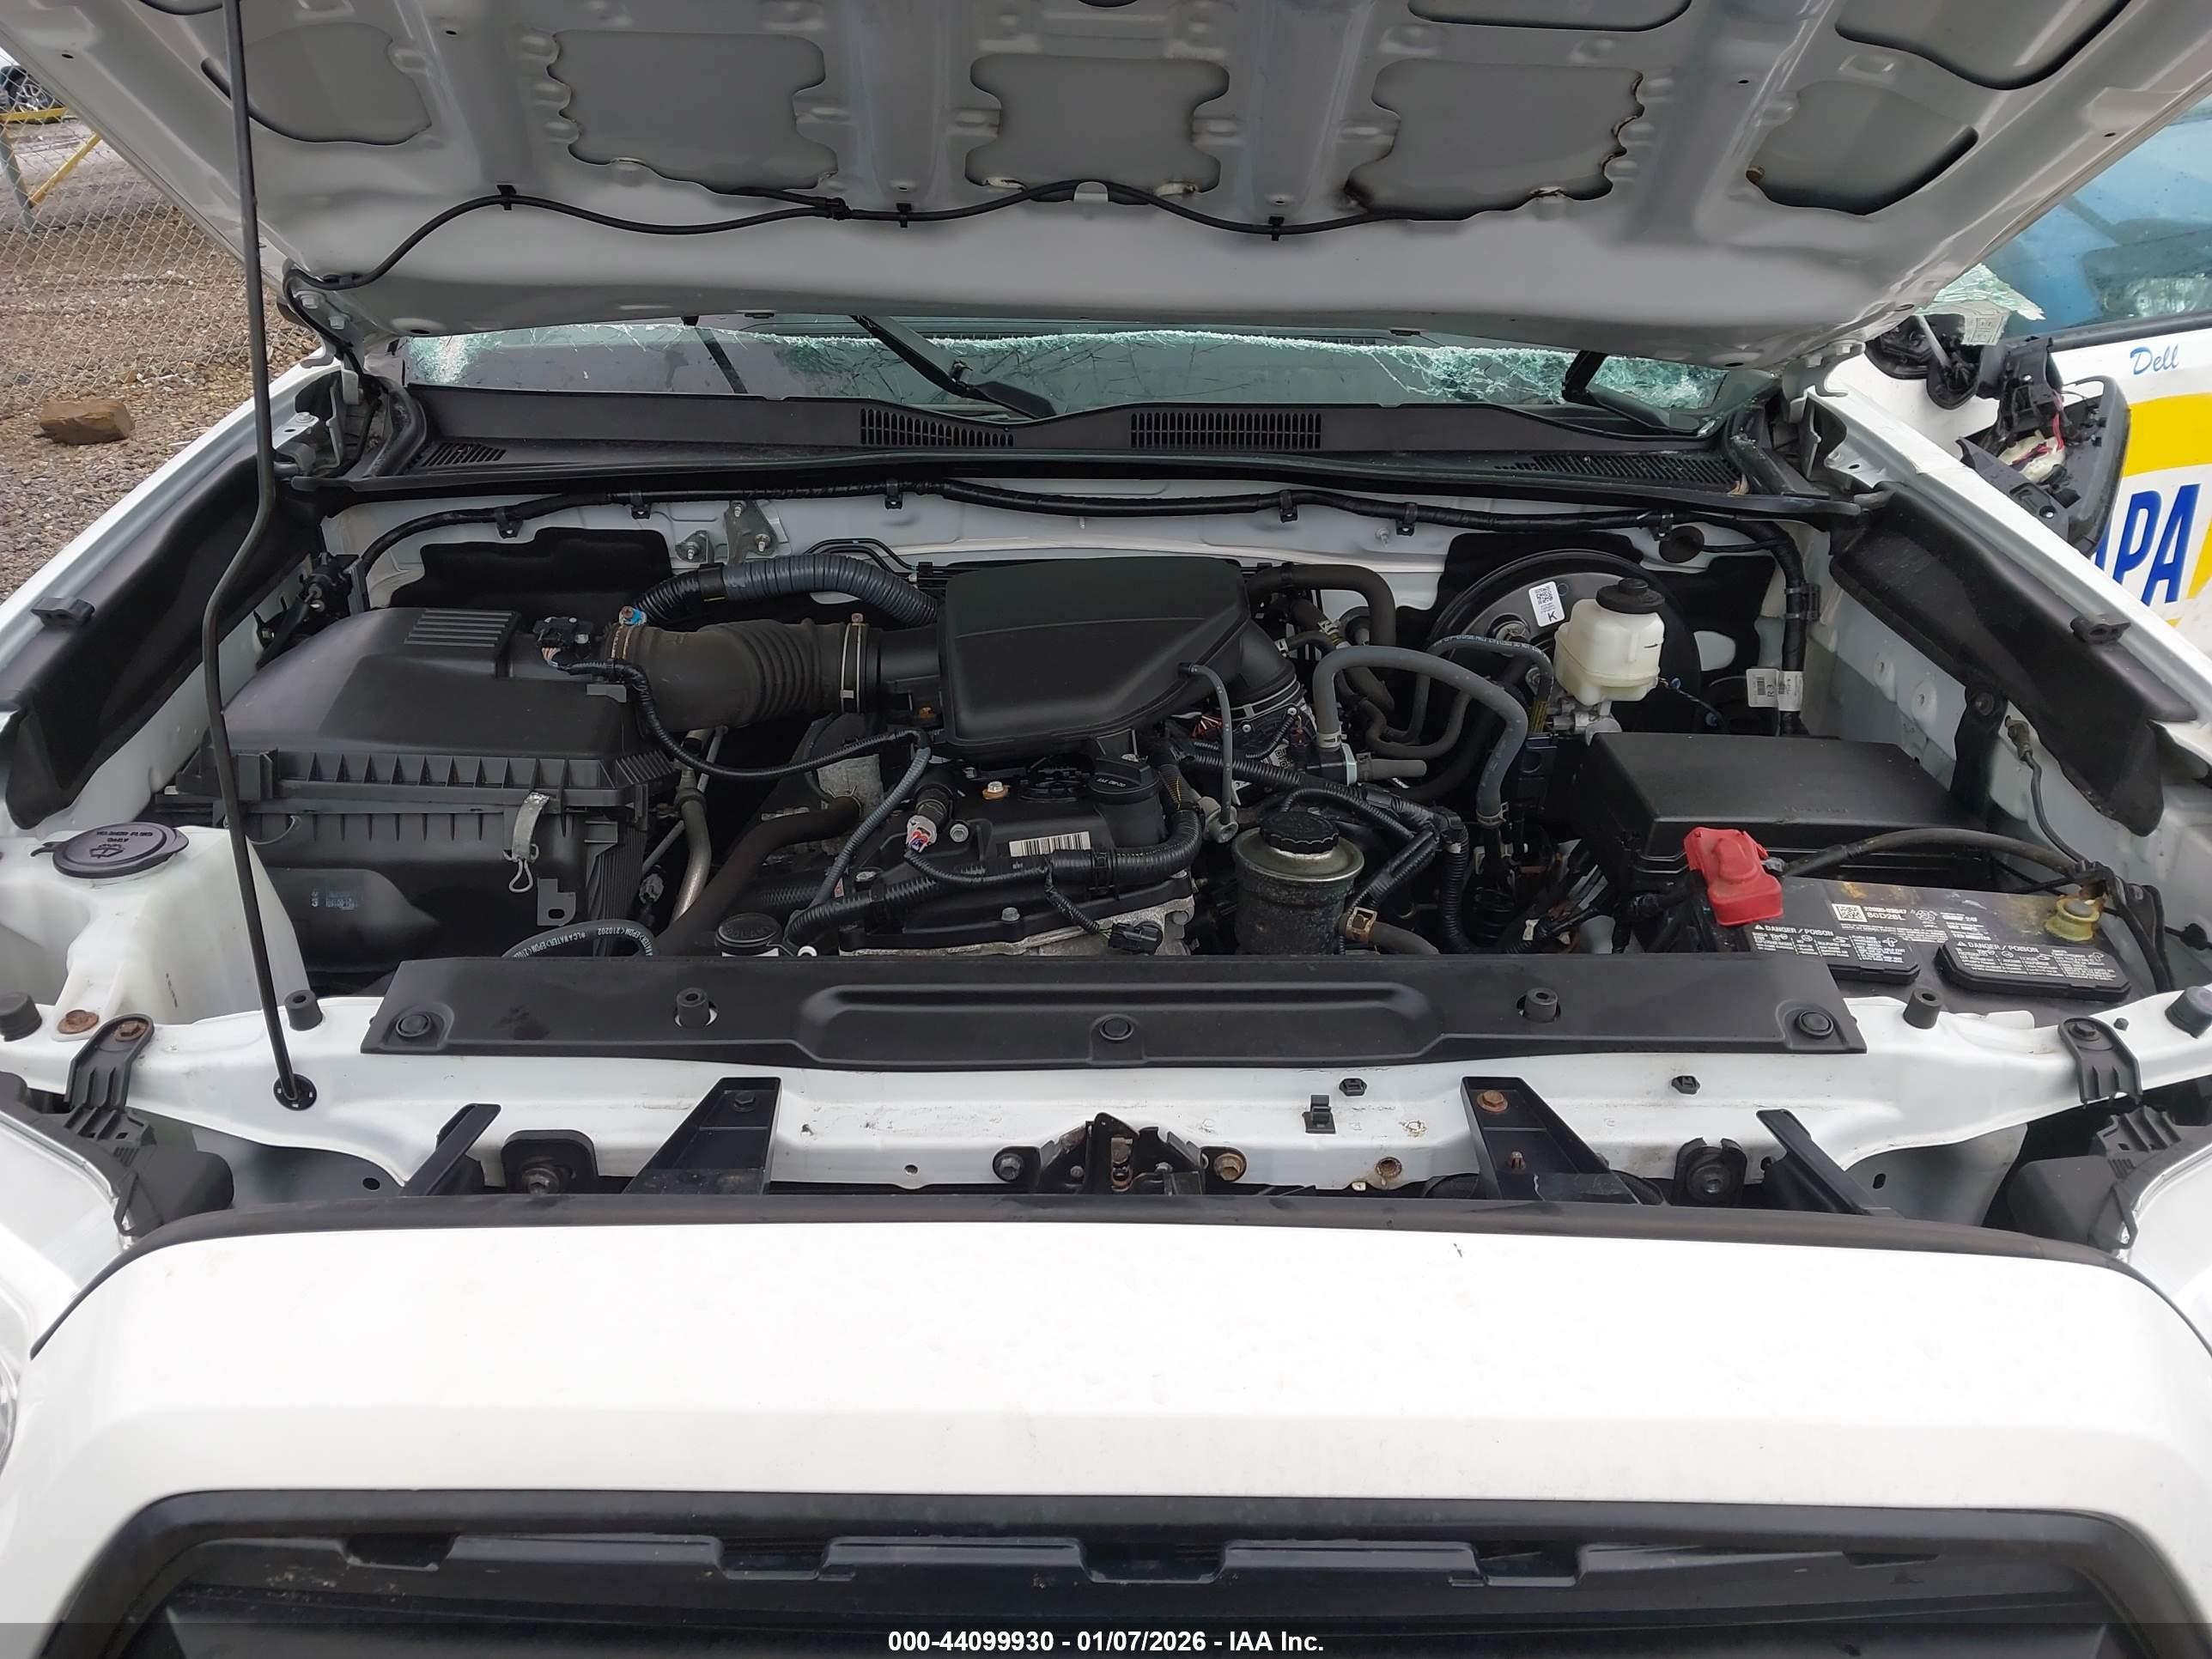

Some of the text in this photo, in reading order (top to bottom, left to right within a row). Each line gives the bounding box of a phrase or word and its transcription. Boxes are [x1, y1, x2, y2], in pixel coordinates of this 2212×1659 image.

[2130, 343, 2179, 375] Dell
[2094, 483, 2201, 607] PA
[1547, 611, 1558, 623] K
[1765, 925, 1797, 934] DANGER
[1804, 928, 1834, 937] POISON
[1967, 941, 1999, 951] DANGER
[2008, 945, 2039, 953] POISON
